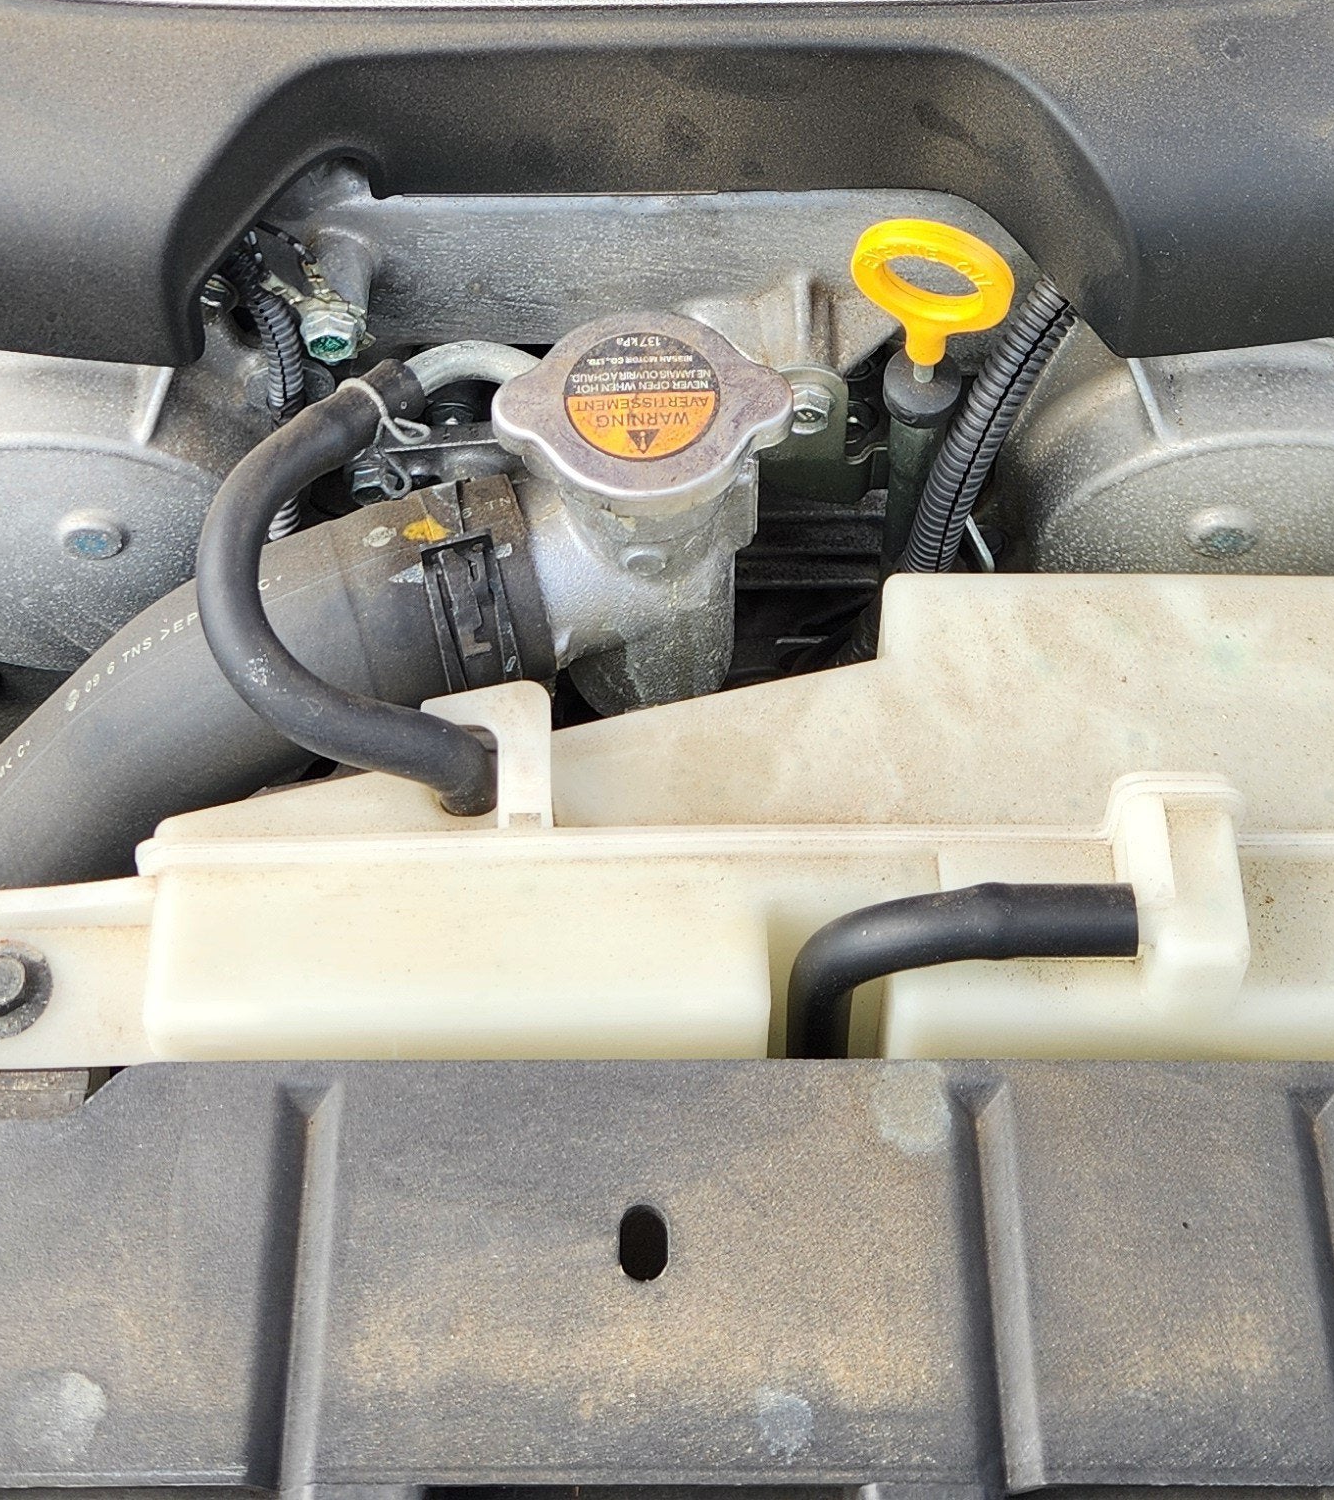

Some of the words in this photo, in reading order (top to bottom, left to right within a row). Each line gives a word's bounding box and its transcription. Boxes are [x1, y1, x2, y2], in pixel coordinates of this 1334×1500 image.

[858, 243, 939, 270] ENGE
[955, 261, 994, 286] OIL
[616, 336, 638, 348] kPa
[639, 336, 661, 347] 137
[625, 356, 659, 364] MOTOR
[660, 354, 693, 363] NISSAN
[619, 370, 659, 380] OUVRIR
[659, 369, 697, 379] JAMAIS
[697, 369, 712, 378] NE
[601, 382, 636, 392] WHEN
[638, 381, 670, 390] OPEN
[672, 380, 709, 389] NEVER
[575, 396, 710, 412] AVERTISSEMENT
[596, 411, 690, 428] WARNING
[84, 673, 100, 693] 09
[106, 661, 115, 675] 6
[121, 636, 152, 663] TNS
